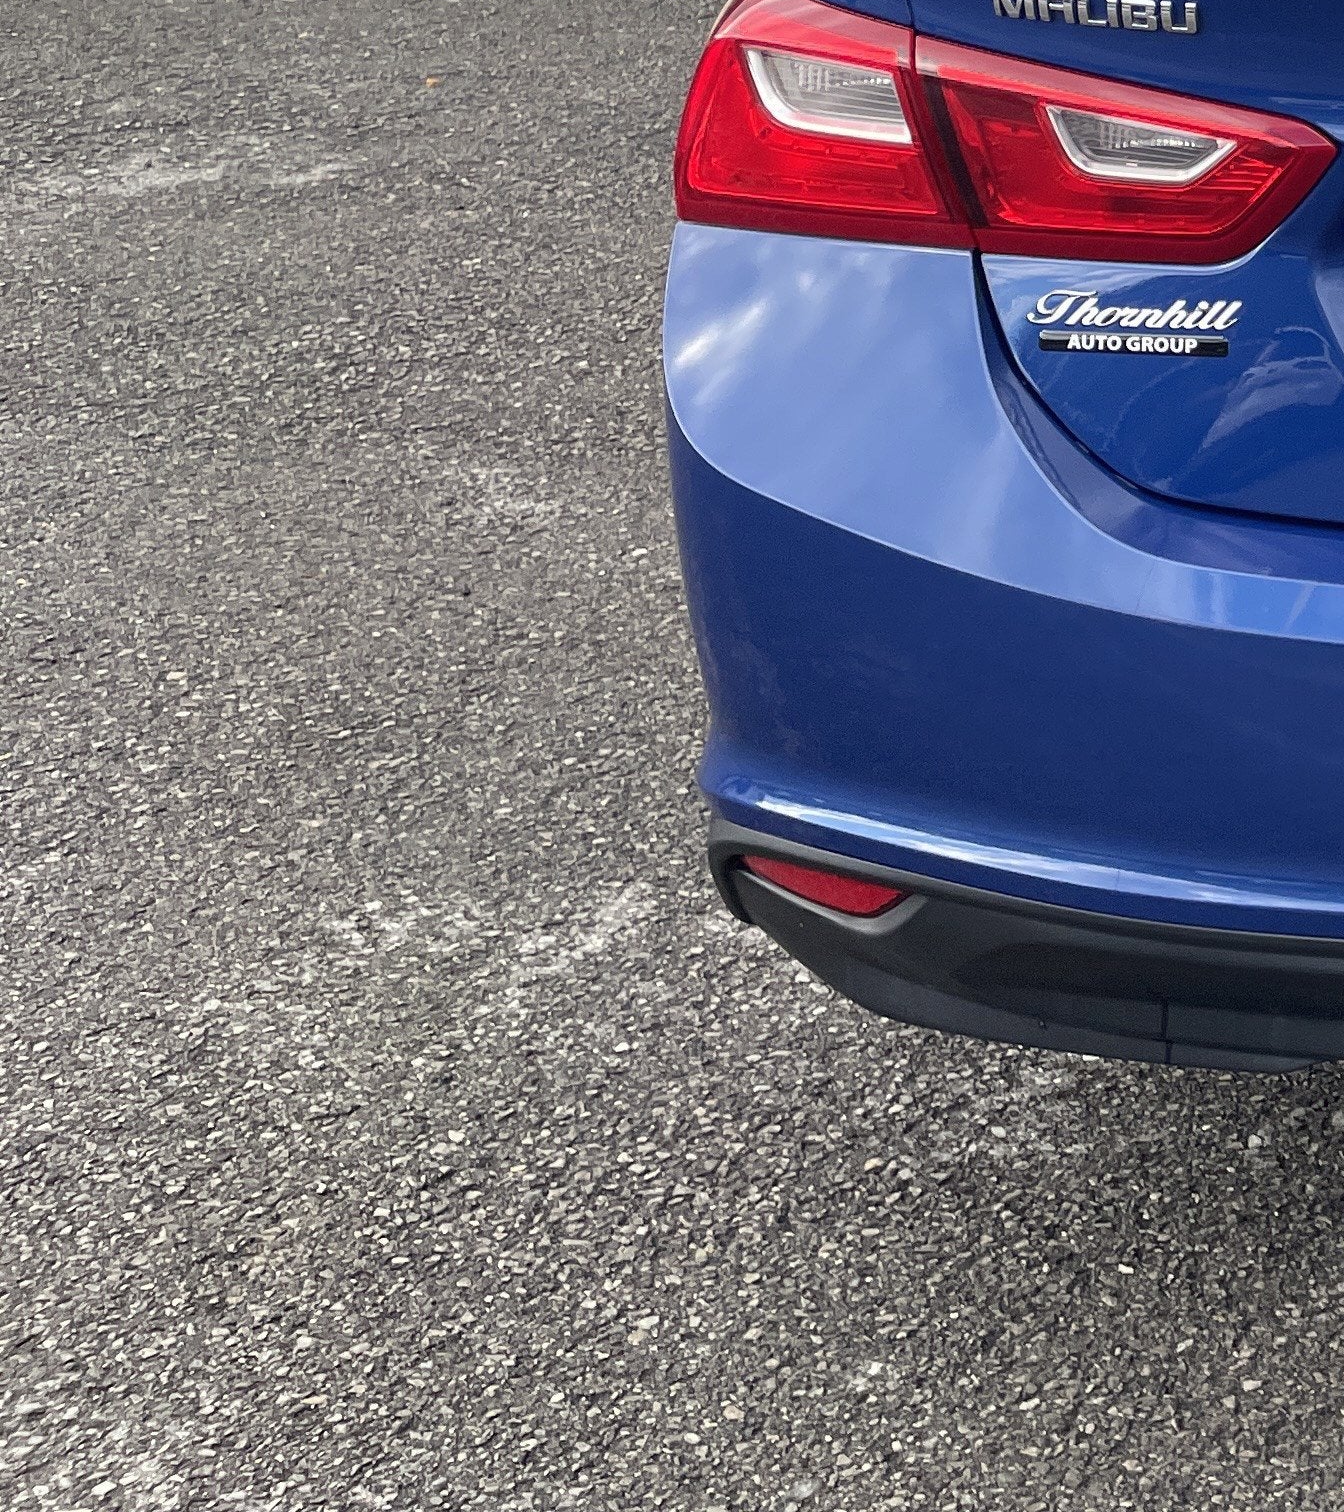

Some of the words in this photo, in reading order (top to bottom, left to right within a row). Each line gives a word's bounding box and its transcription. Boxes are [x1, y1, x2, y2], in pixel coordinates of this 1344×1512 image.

[1026, 289, 1243, 331] Thornhill
[1067, 334, 1122, 352] AUTO
[1125, 336, 1198, 354] GROUP
